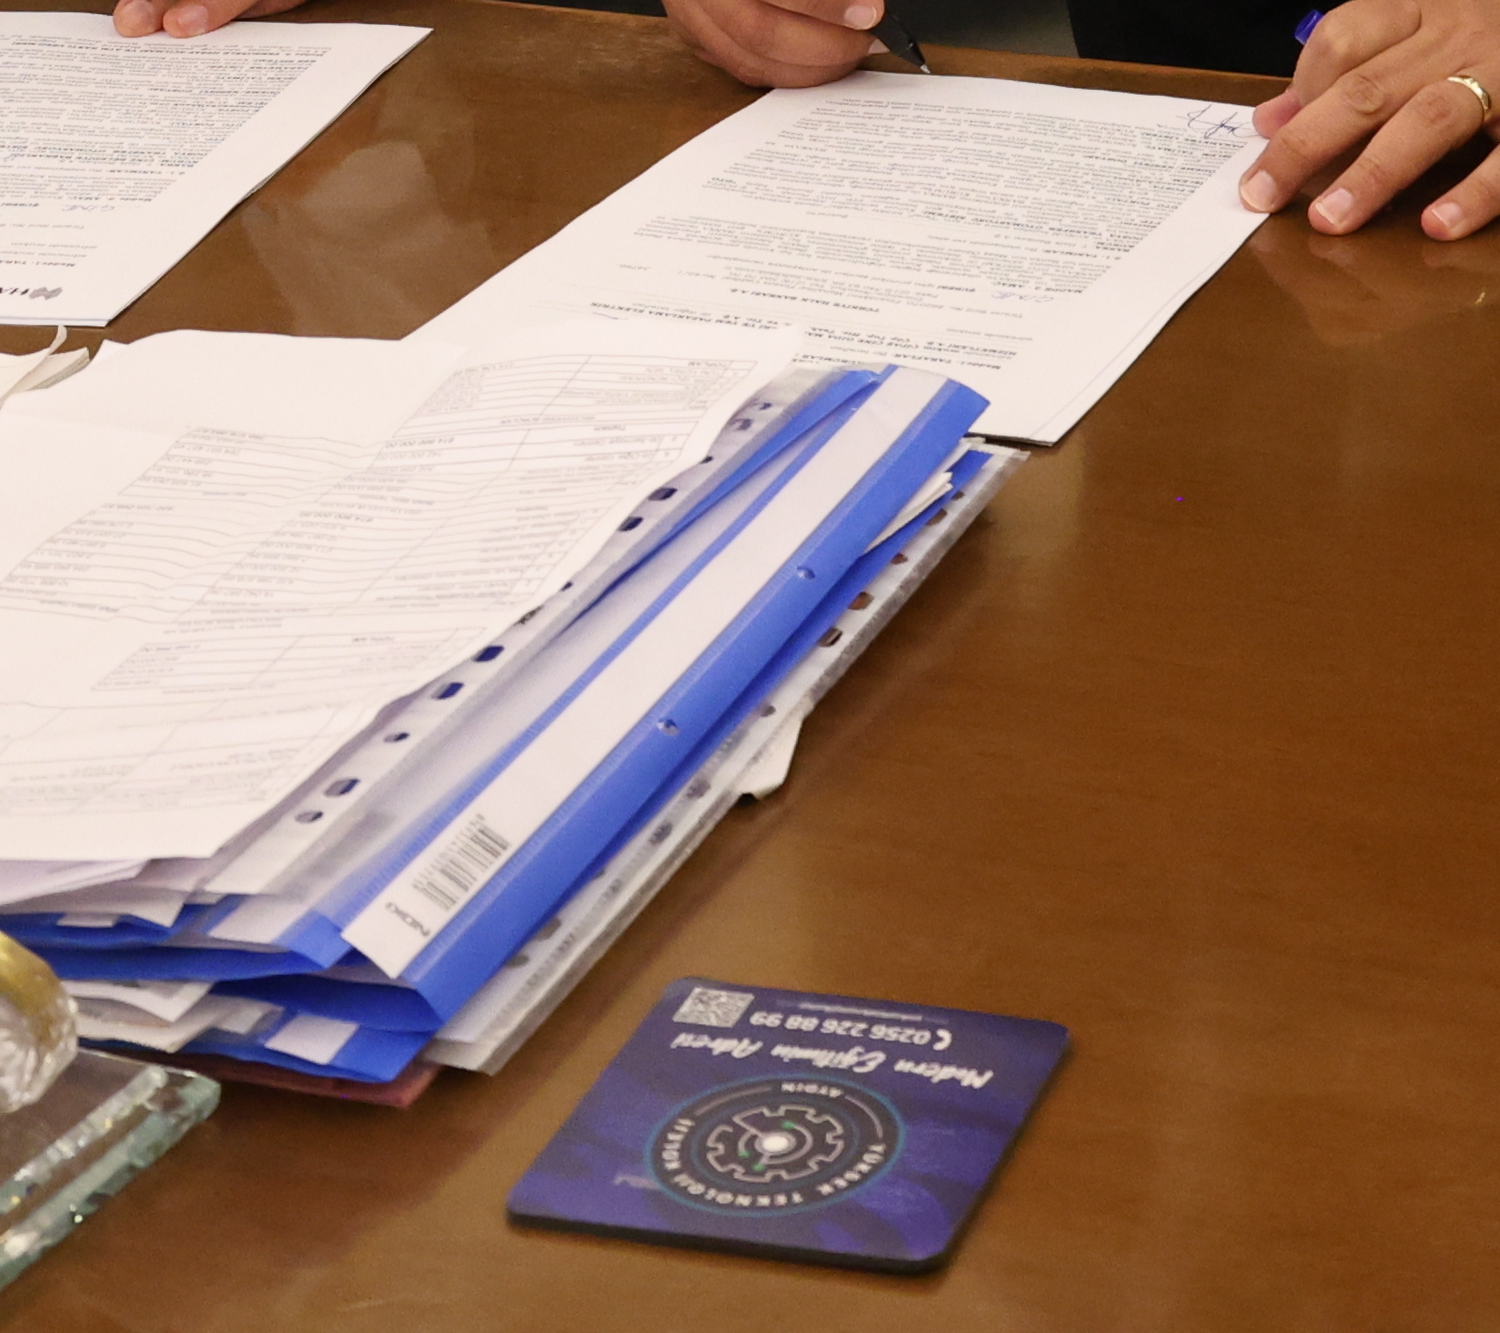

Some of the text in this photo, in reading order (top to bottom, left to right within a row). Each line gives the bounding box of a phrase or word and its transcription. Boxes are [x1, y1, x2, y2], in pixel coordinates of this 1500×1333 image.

[750, 1011, 783, 1030] 99
[784, 1014, 820, 1033] 88
[824, 1017, 869, 1038] 226
[670, 1032, 763, 1059] Adresi
[869, 1024, 932, 1046] 0256
[893, 1058, 995, 1090] Modern
